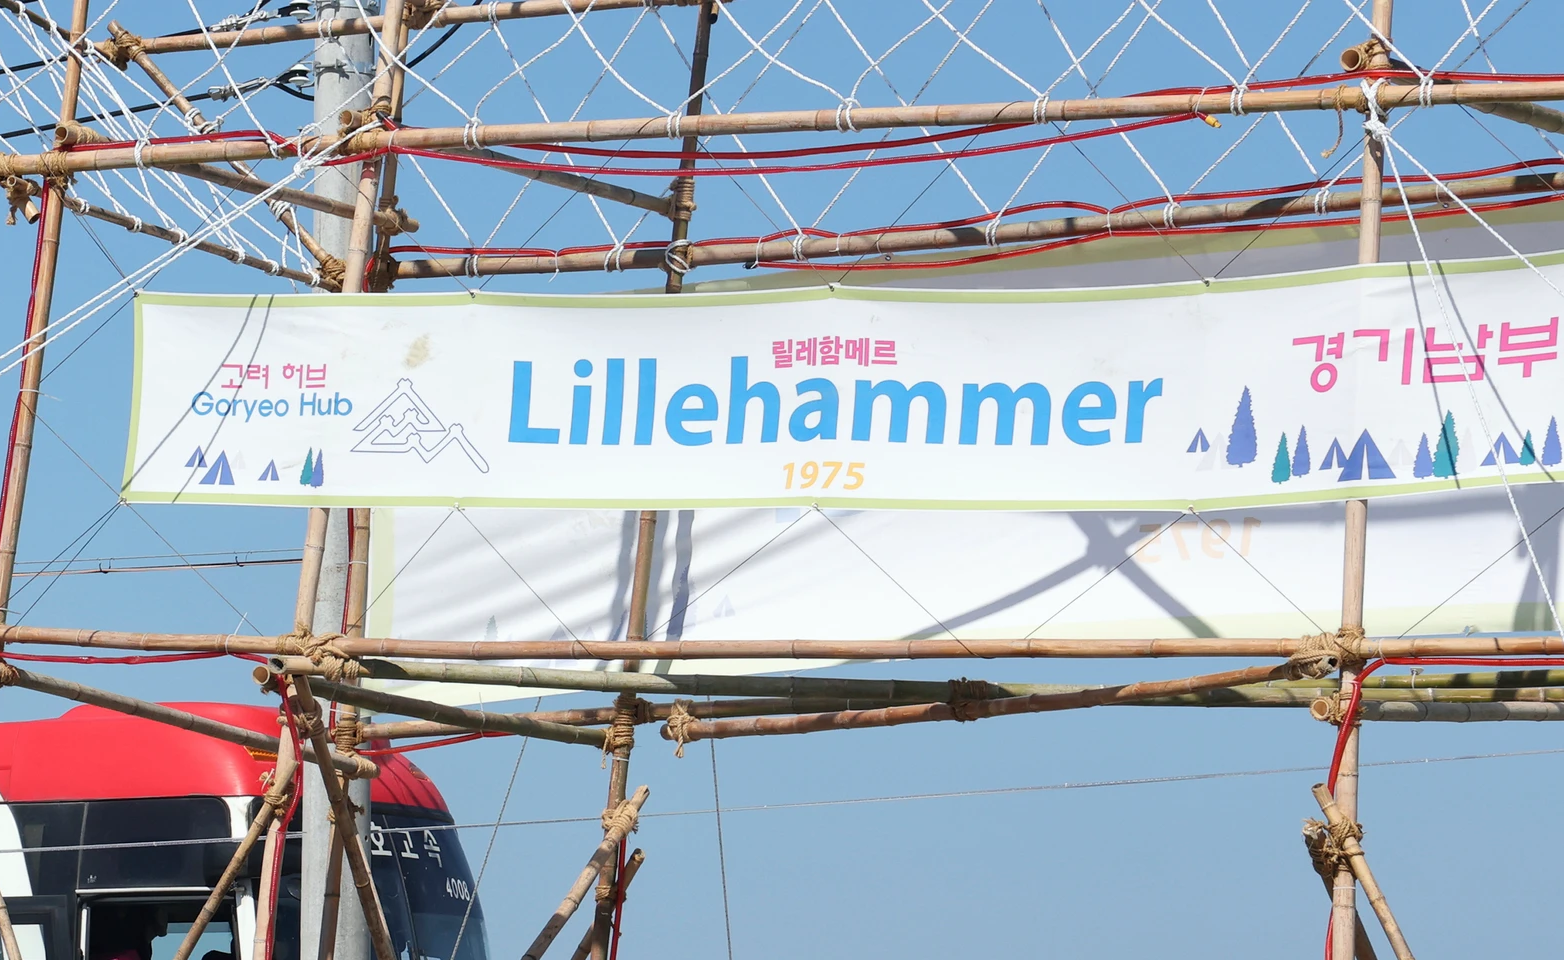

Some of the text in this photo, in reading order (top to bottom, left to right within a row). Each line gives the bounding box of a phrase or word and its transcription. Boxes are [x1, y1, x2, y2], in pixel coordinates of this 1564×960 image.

[771, 335, 898, 368] 릴레함메르
[1292, 317, 1560, 393] 경기남부
[220, 363, 328, 390] 고려 허브
[190, 390, 354, 422] Goryeo Hub
[508, 356, 1164, 447] Lillehammer
[782, 460, 865, 490] 1975
[370, 821, 442, 868] 호고속
[445, 877, 470, 902] 4008
